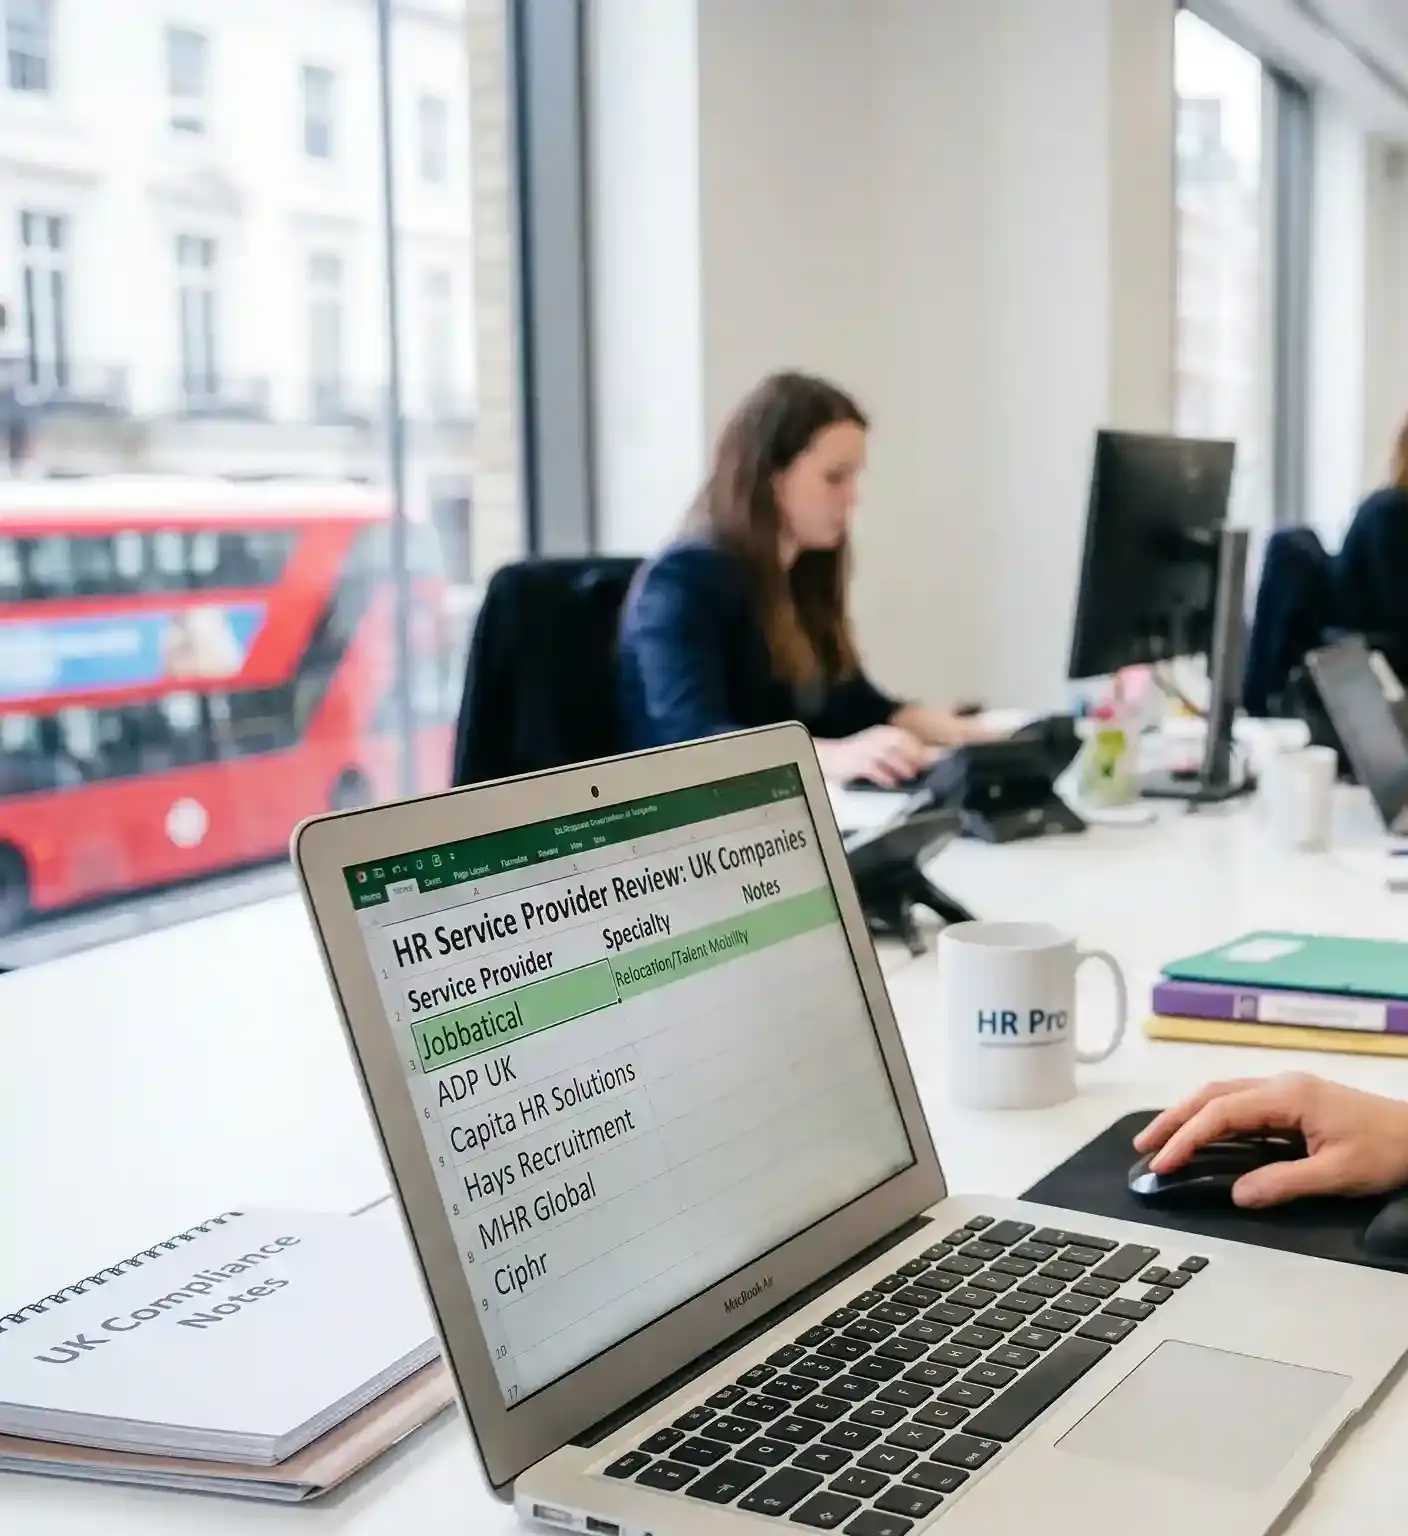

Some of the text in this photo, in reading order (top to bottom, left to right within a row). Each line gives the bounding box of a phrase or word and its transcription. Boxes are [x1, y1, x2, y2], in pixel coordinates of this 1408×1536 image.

[392, 829, 807, 968] HR Service Provider Review: UK Companies
[742, 877, 781, 904] Notes
[602, 913, 672, 951] Specialty
[407, 951, 553, 1013] Service Provider
[422, 1001, 524, 1060] Jobbatical
[978, 1008, 1068, 1036] HR Pro
[438, 1055, 517, 1107] ADP UK
[450, 1063, 636, 1153] Capita HR Solutions
[464, 1108, 636, 1202] Hays Recruitment
[479, 1171, 597, 1250] MHR Global
[34, 1234, 301, 1365] UK Compliance
[177, 1275, 290, 1329] Notes
[494, 1253, 548, 1295] Ciphr
[724, 1282, 763, 1315] MacBook
